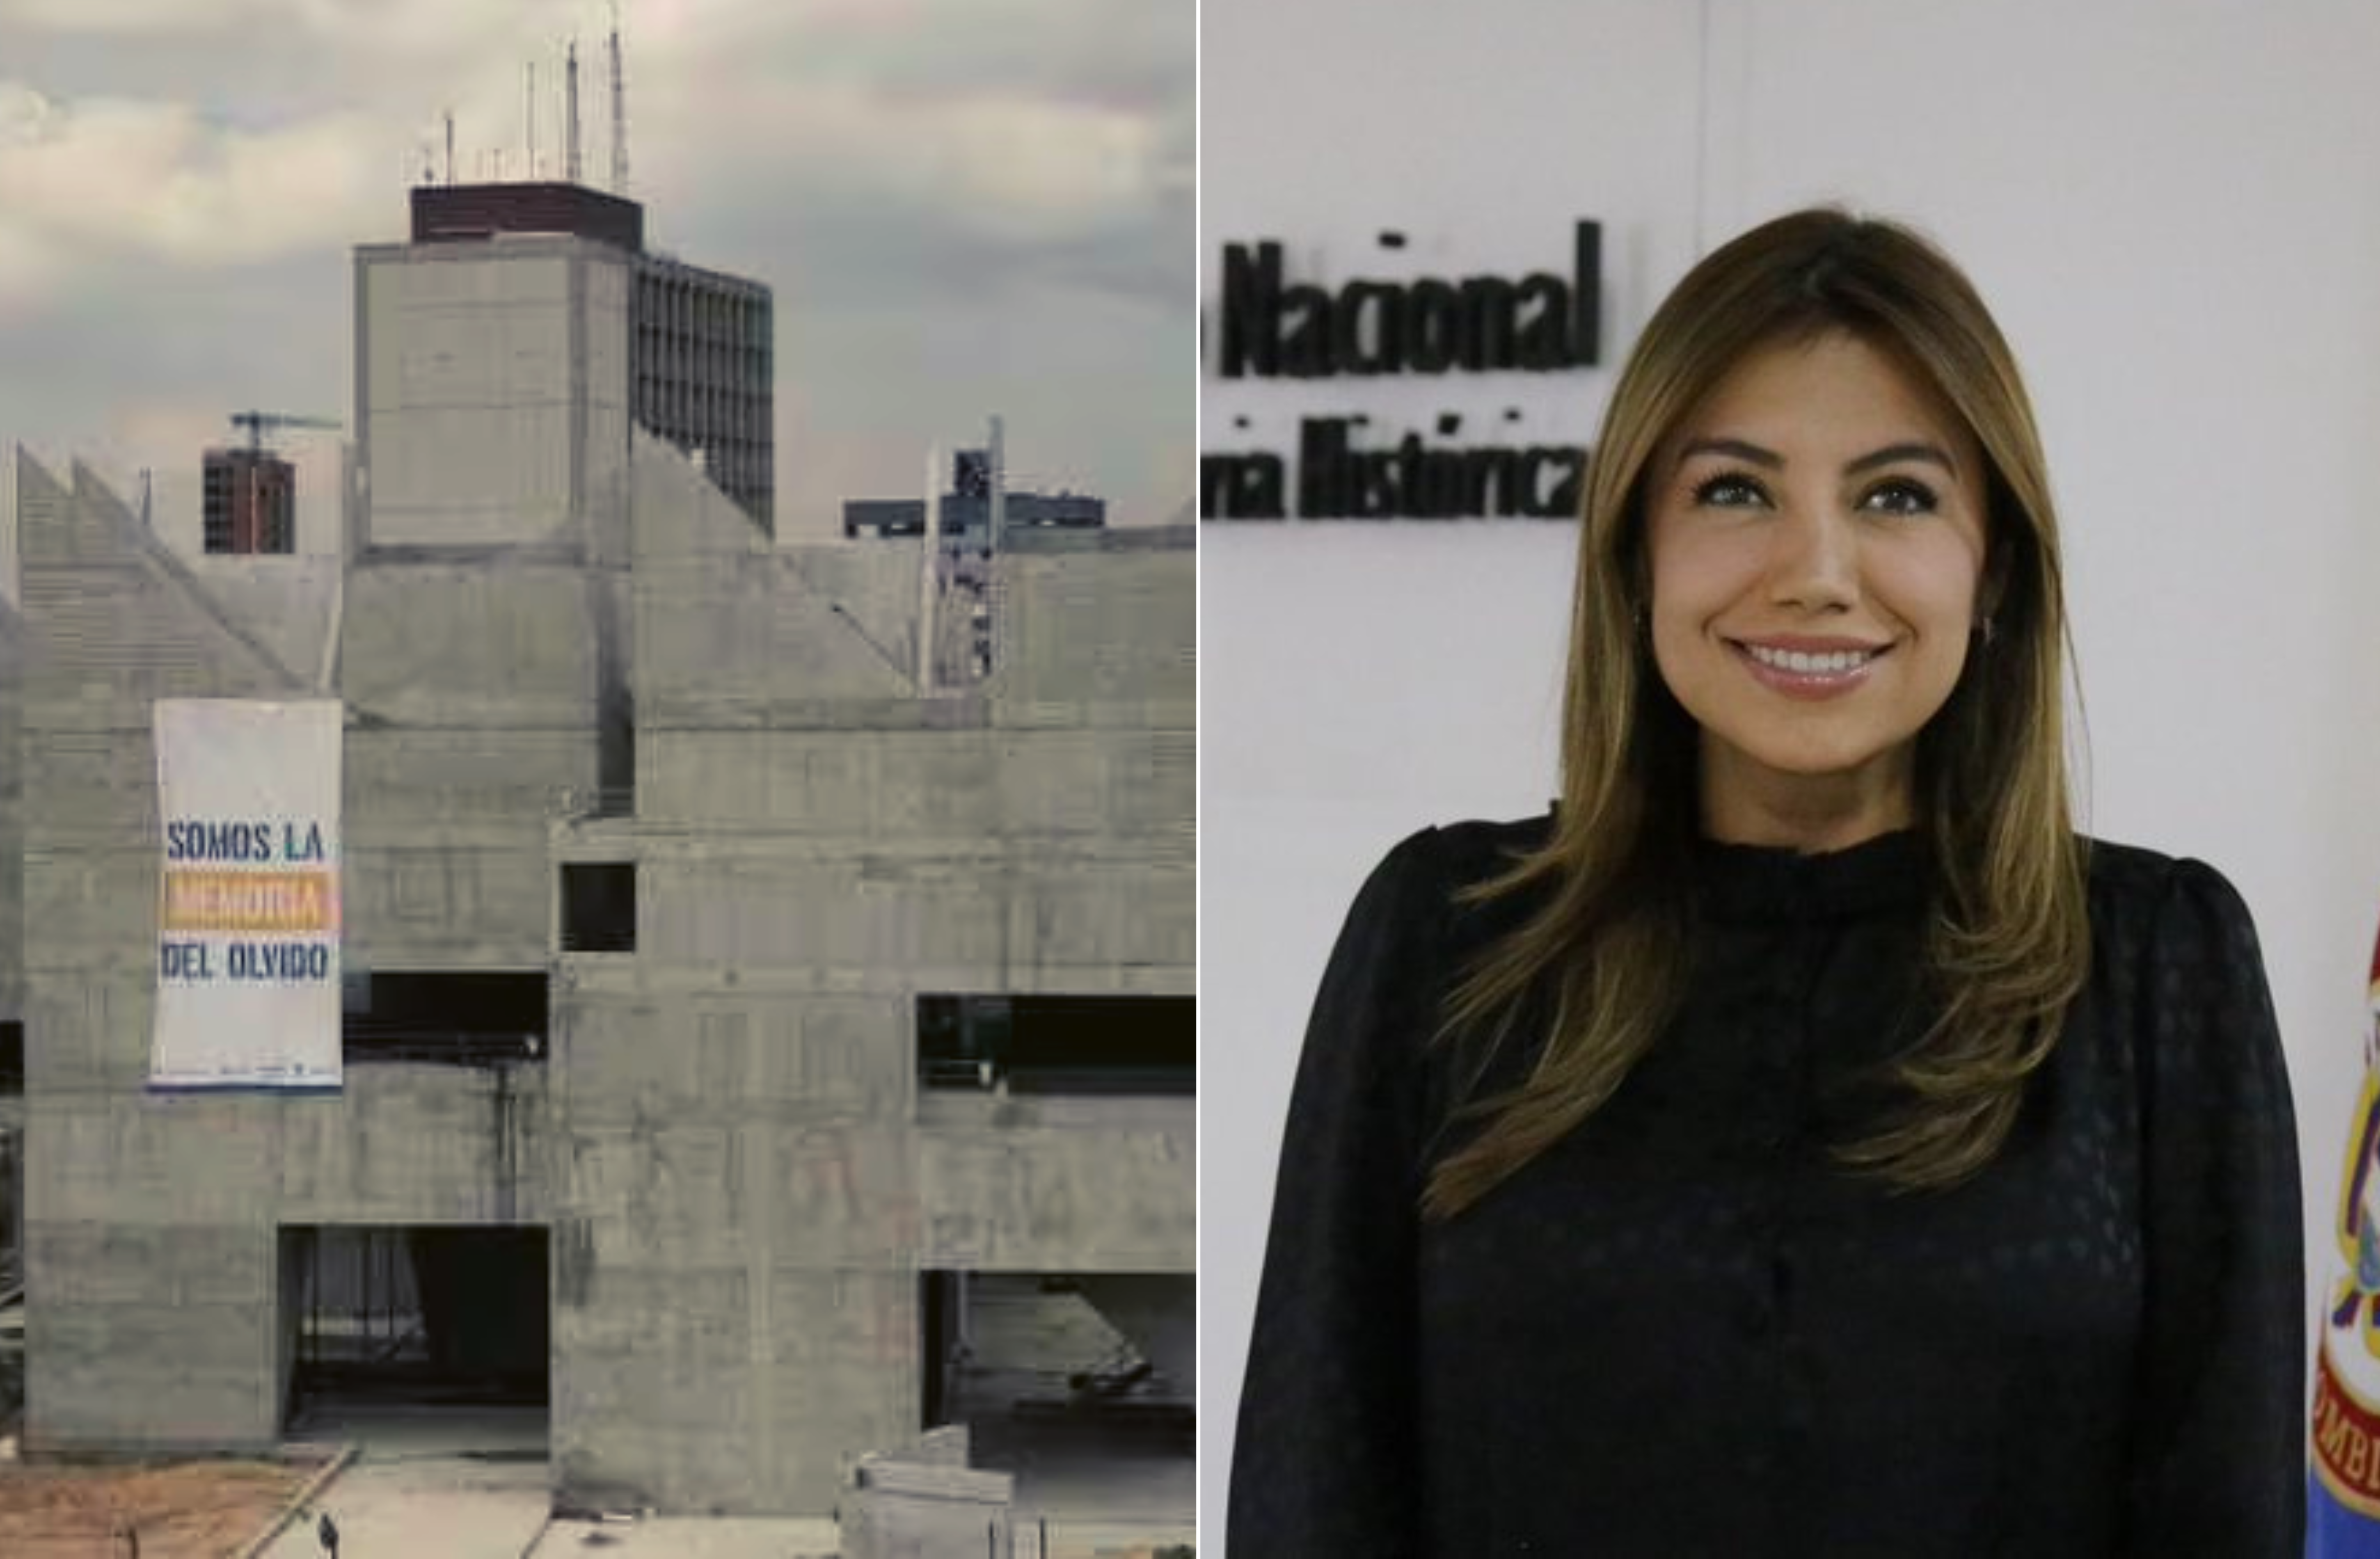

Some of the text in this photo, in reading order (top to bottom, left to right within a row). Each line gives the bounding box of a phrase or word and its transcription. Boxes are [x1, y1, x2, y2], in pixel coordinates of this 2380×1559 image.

[1220, 218, 1602, 378] Nacional
[167, 821, 323, 861] SOMOS LA
[162, 942, 328, 980] DEL OLVIDO
